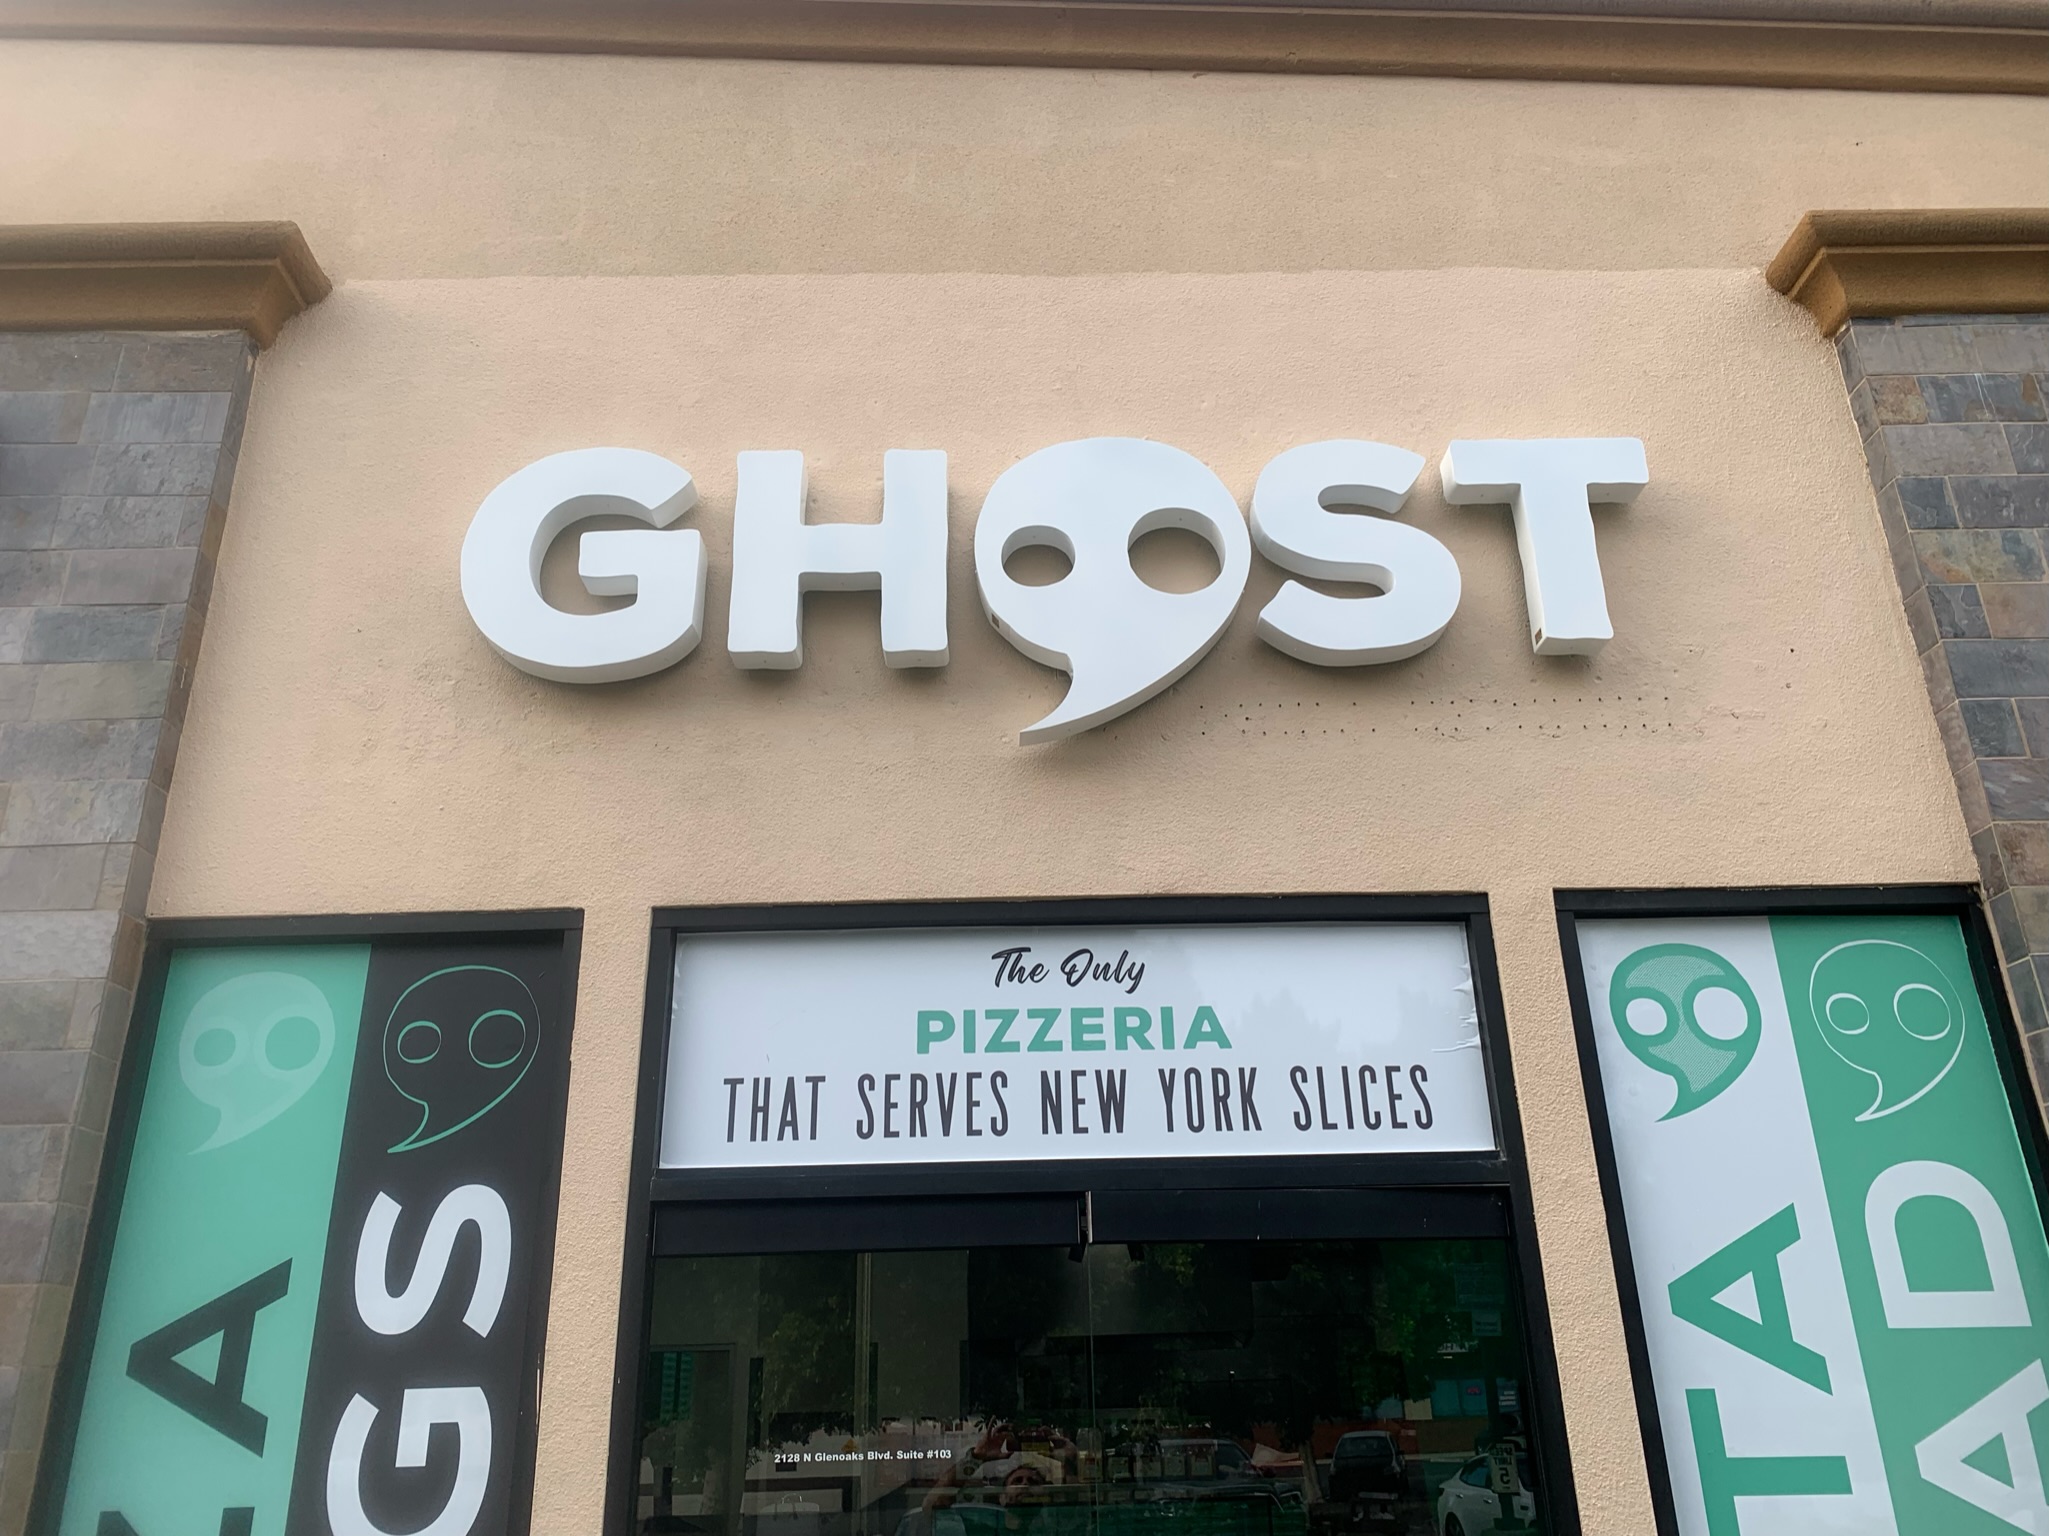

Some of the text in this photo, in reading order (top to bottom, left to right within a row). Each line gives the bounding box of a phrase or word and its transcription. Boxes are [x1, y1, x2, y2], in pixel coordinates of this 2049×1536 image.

[459, 436, 1650, 748] GHOST
[990, 946, 1146, 994] The Only
[916, 1005, 1233, 1055] PIZZERIA
[723, 1064, 1434, 1143] THAT SERVES NEW YORK SLICES
[774, 1449, 952, 1464] 2128 N Glenoaks Blvd. Suite #103
